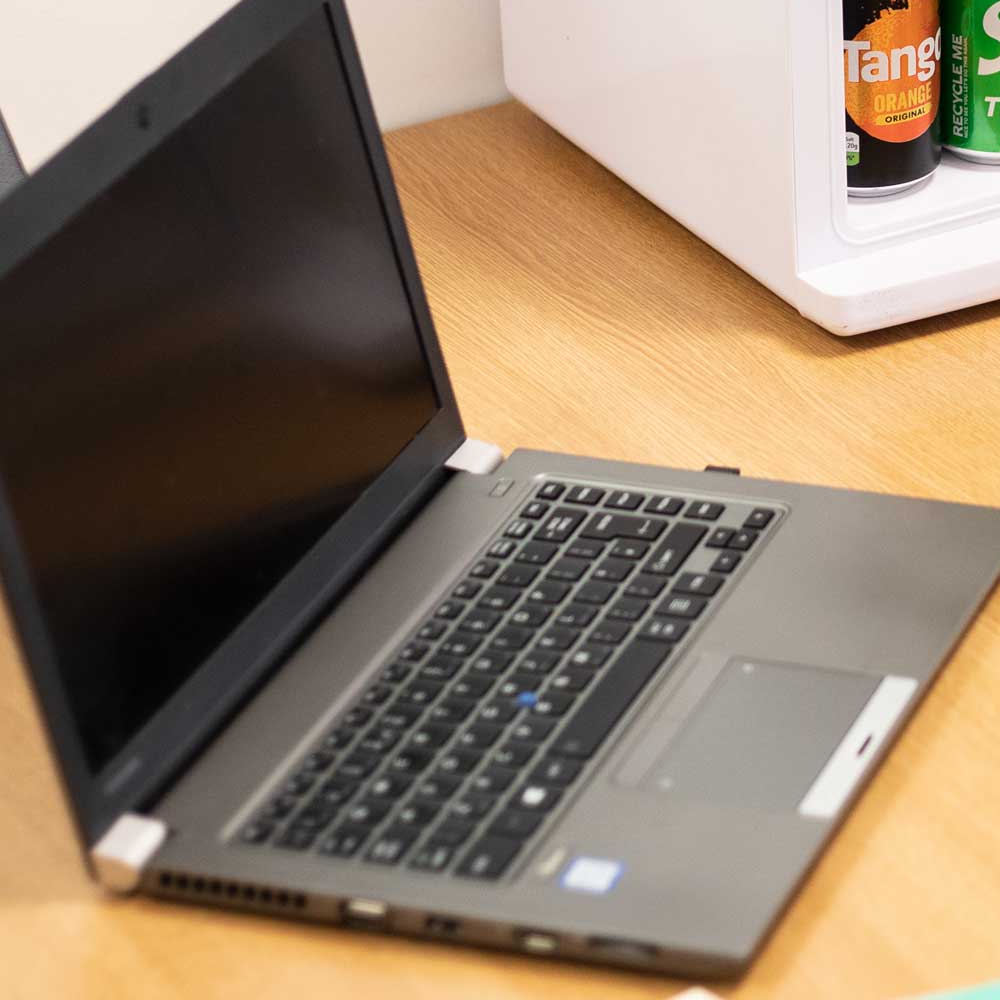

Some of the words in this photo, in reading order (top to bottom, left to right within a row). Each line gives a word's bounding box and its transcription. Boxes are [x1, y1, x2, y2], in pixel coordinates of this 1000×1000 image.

[952, 34, 963, 60] ME
[873, 81, 933, 114] ORANGE
[952, 63, 963, 137] RECYCLE
[884, 106, 926, 124] ORIGINAL
